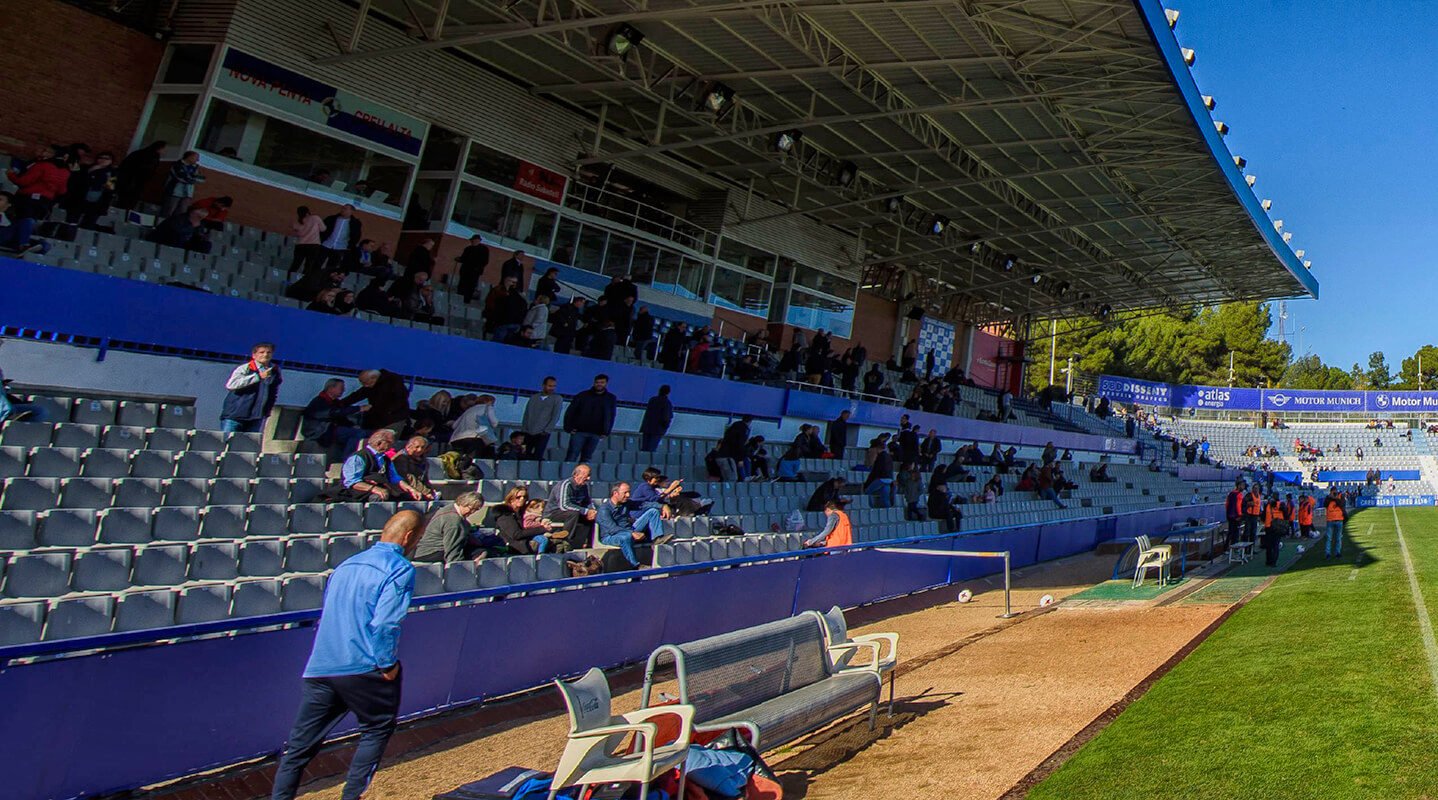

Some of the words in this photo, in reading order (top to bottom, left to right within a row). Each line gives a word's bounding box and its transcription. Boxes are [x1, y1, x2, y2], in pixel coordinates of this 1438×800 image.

[228, 64, 267, 89] NOVA
[1205, 388, 1230, 401] atlas
[1294, 396, 1325, 405] MOTOR
[1327, 396, 1361, 405] MUNICH
[1392, 396, 1421, 406] Motor
